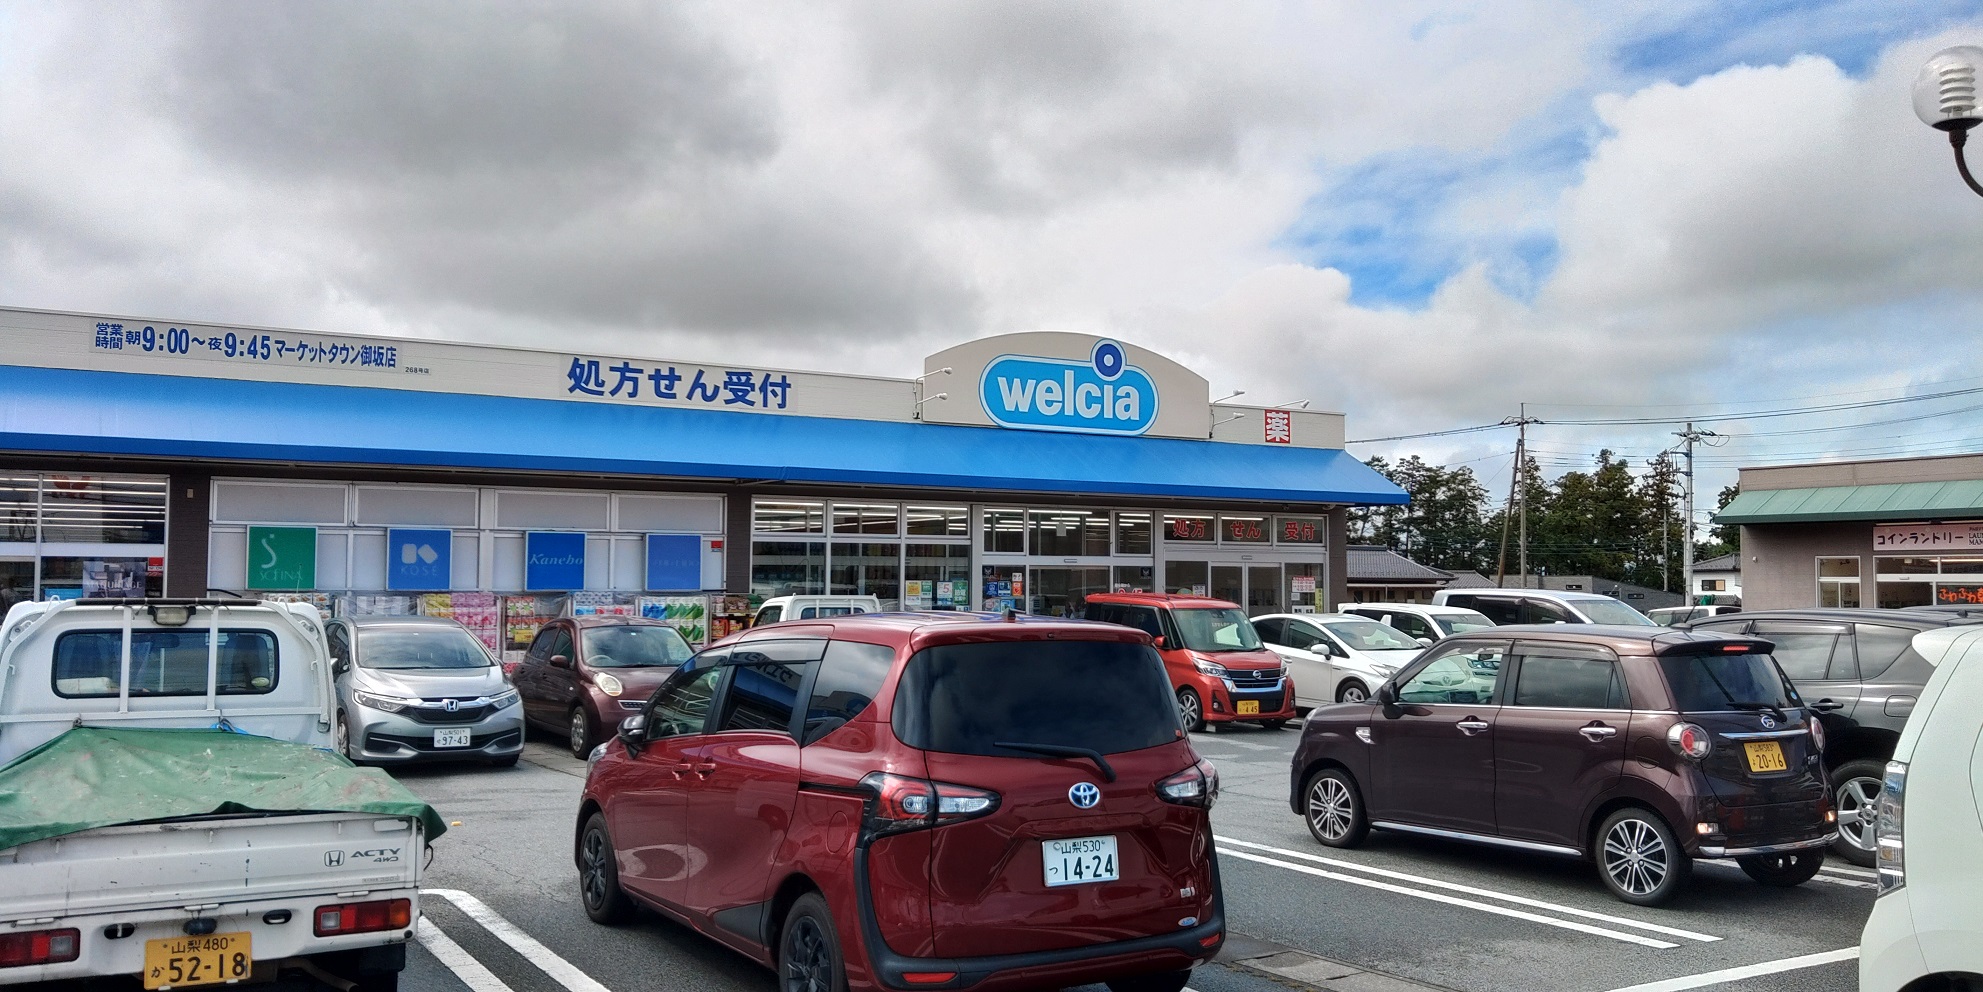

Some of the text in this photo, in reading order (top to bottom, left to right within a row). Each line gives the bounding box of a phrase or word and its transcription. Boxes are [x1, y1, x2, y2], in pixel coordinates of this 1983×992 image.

[96, 322, 123, 336] 営業
[95, 336, 123, 350] 時間
[567, 357, 792, 409] 処方せん受付
[997, 370, 1140, 421] welcia
[1266, 412, 1290, 443] 薬
[1173, 518, 1315, 541] 処方 せん 受付
[1877, 531, 1964, 545] コインランドリー
[530, 553, 583, 565] Kanebo
[1756, 753, 1784, 769] 20-16
[350, 848, 401, 858] ACTY
[1061, 840, 1101, 854] 山梨530
[1064, 854, 1114, 880] 14-24
[171, 937, 229, 954] 山梨480
[151, 952, 245, 983] か 52-18
